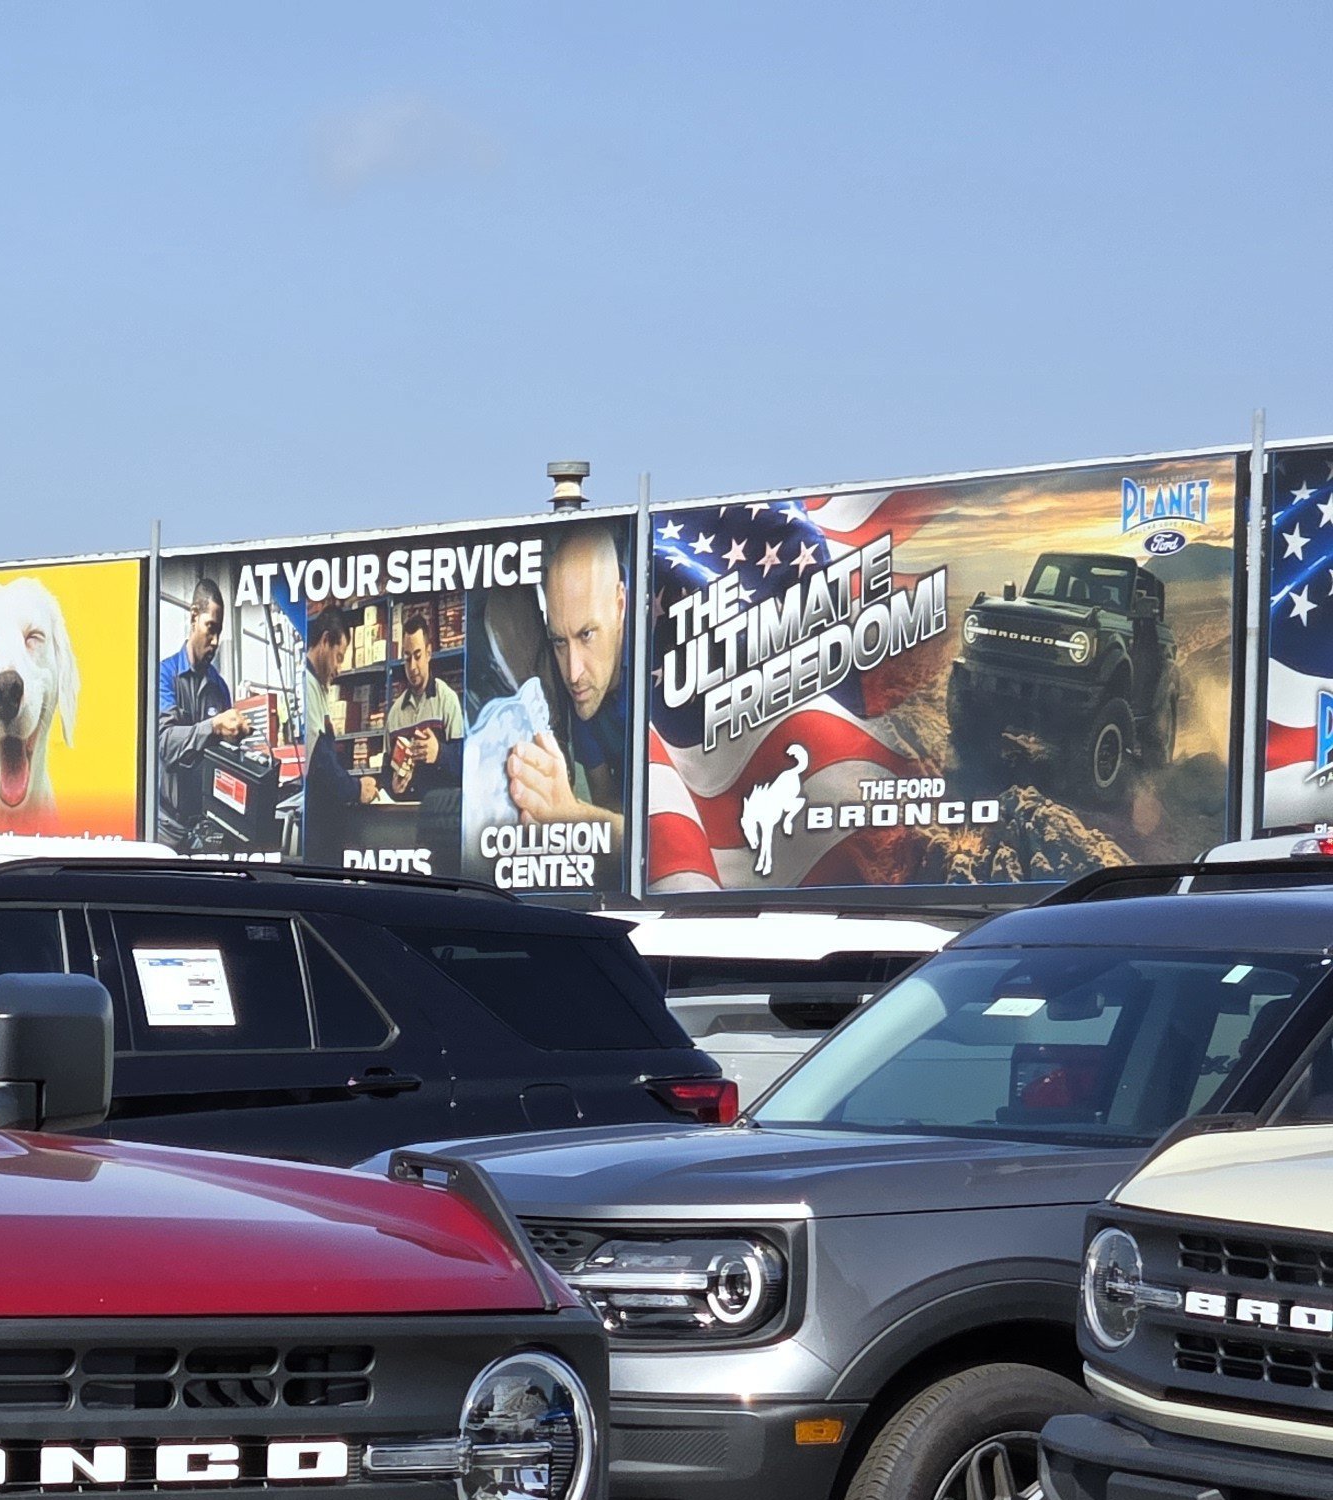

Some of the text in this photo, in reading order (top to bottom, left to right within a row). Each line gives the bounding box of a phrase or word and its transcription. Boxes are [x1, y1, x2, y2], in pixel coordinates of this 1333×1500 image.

[1121, 477, 1211, 533] PLANET
[1150, 533, 1180, 552] Ford
[235, 539, 544, 607] AT YOUR SERVICE
[663, 531, 893, 710] ULTIMATE
[668, 571, 741, 645] THE
[703, 565, 949, 753] FREEDOM!
[860, 777, 946, 801] THE FORD
[806, 799, 1001, 830] BRONCO
[480, 822, 612, 859] COLLISION
[494, 854, 595, 890] CENTER
